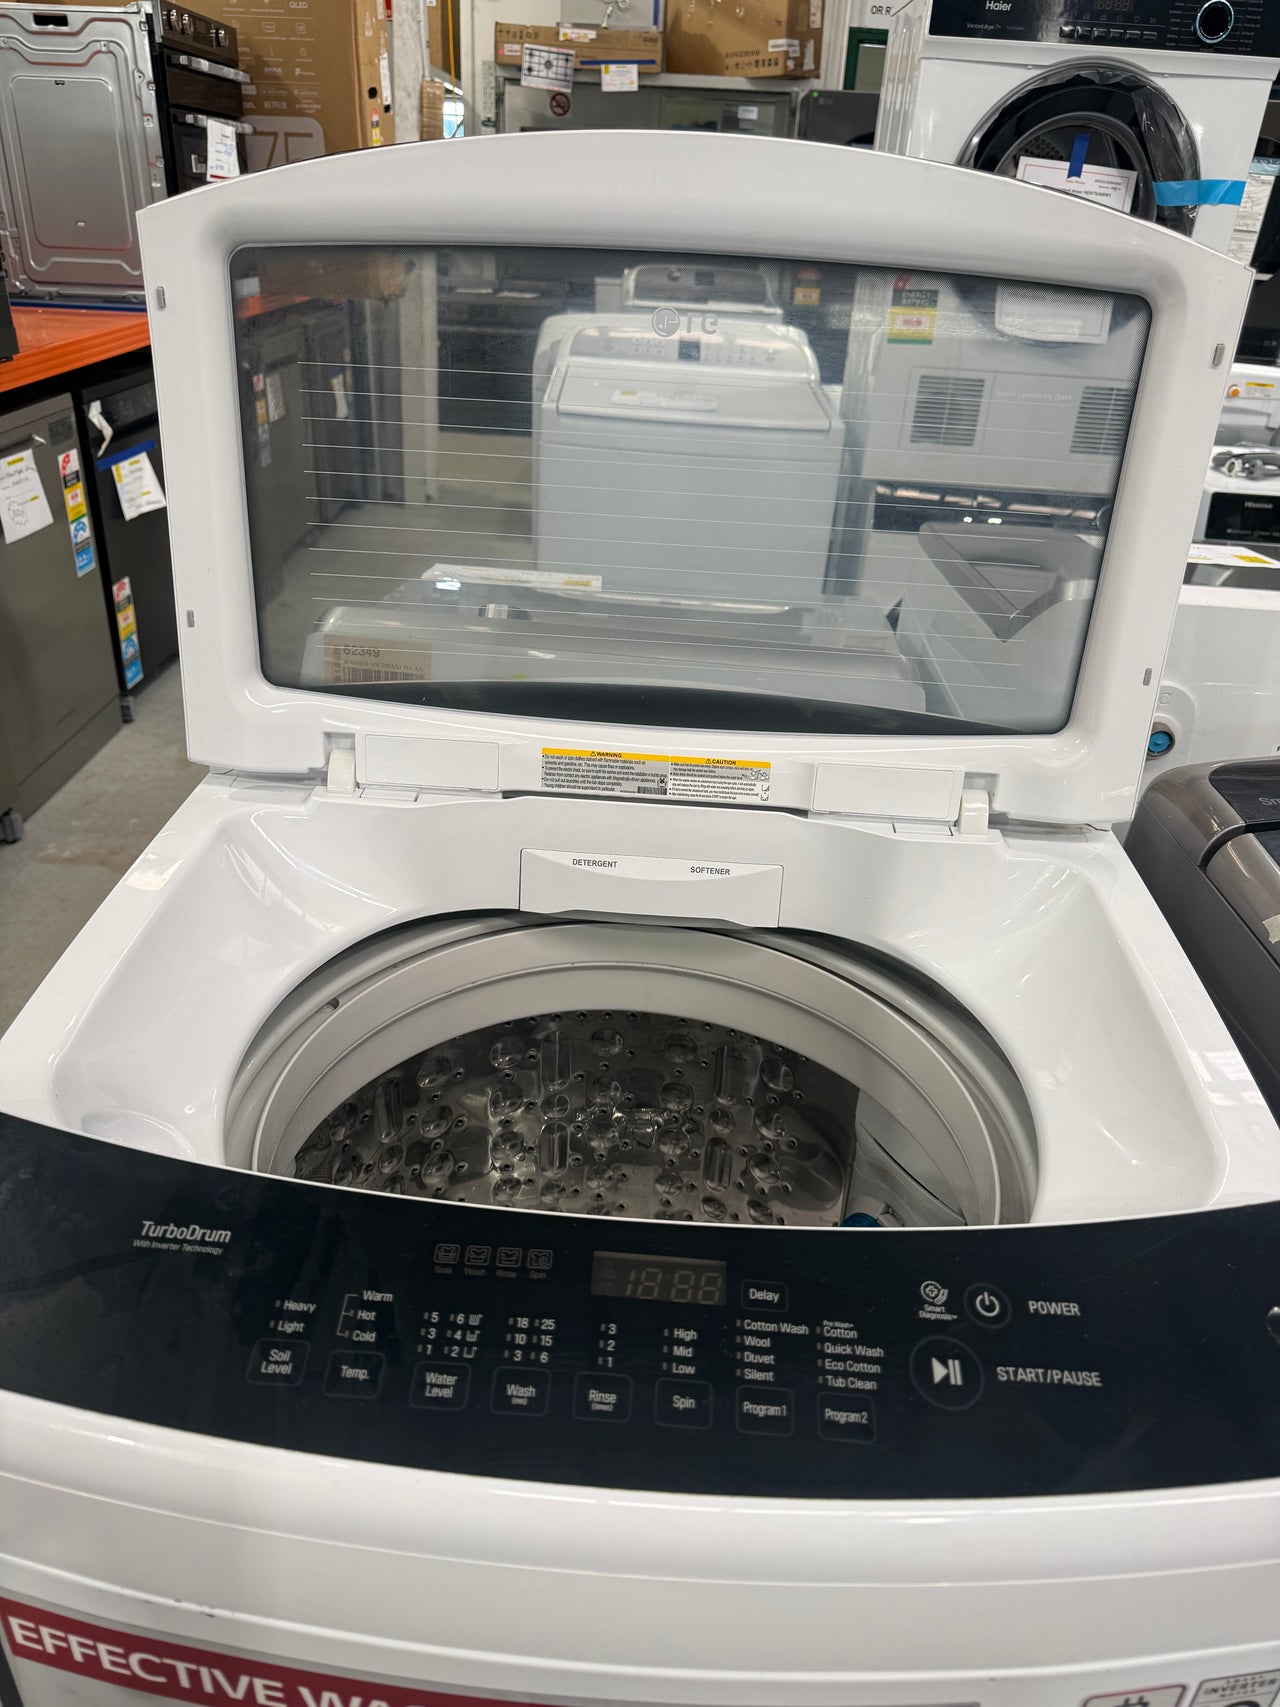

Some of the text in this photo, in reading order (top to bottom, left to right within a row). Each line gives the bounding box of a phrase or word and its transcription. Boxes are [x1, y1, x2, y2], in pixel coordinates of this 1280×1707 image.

[871, 5, 883, 15] OR
[985, 0, 1012, 11] Haier
[572, 858, 617, 869] DETERGENT
[690, 866, 731, 876] SOFTENER
[140, 1221, 232, 1243] TurboDrum
[133, 1239, 223, 1255] With Inverter Technology
[363, 1290, 393, 1302] Warm
[749, 1288, 780, 1303] Delay
[284, 1301, 316, 1314] Heavy
[1028, 1300, 1081, 1317] POWER
[357, 1310, 376, 1321] Hot
[430, 1312, 465, 1325] 5 6
[278, 1321, 305, 1334] Light
[517, 1318, 555, 1330] 18 25
[608, 1324, 617, 1335] 3
[744, 1319, 809, 1335] Cotton Wash
[352, 1330, 376, 1342] Cold
[427, 1328, 462, 1340] 3 4
[674, 1328, 697, 1341] High
[823, 1326, 857, 1339] Cotton
[515, 1334, 553, 1346] 10 15
[606, 1340, 616, 1351] 2
[744, 1335, 771, 1348] Wool
[269, 1349, 291, 1362] Soil
[426, 1344, 459, 1357] 1 2
[513, 1350, 549, 1363] 3 6
[673, 1345, 693, 1357] Mid
[824, 1342, 884, 1358] Quick Wash
[744, 1352, 775, 1365] Duvet
[260, 1361, 292, 1375] Level
[340, 1365, 370, 1380] Temp.
[672, 1362, 696, 1374] Low
[825, 1359, 881, 1374] Eco Cotton
[426, 1372, 458, 1385] Water
[744, 1368, 775, 1382] Silent
[995, 1366, 1103, 1387] START/PAUSE
[826, 1375, 877, 1390] Tub Clean
[425, 1385, 453, 1398] Level
[506, 1384, 536, 1397] Wash
[589, 1390, 617, 1403] Rinse
[673, 1395, 696, 1410] Spin
[7, 1615, 289, 1707] EFFECTIVE
[1203, 1679, 1277, 1695] INVERTER
